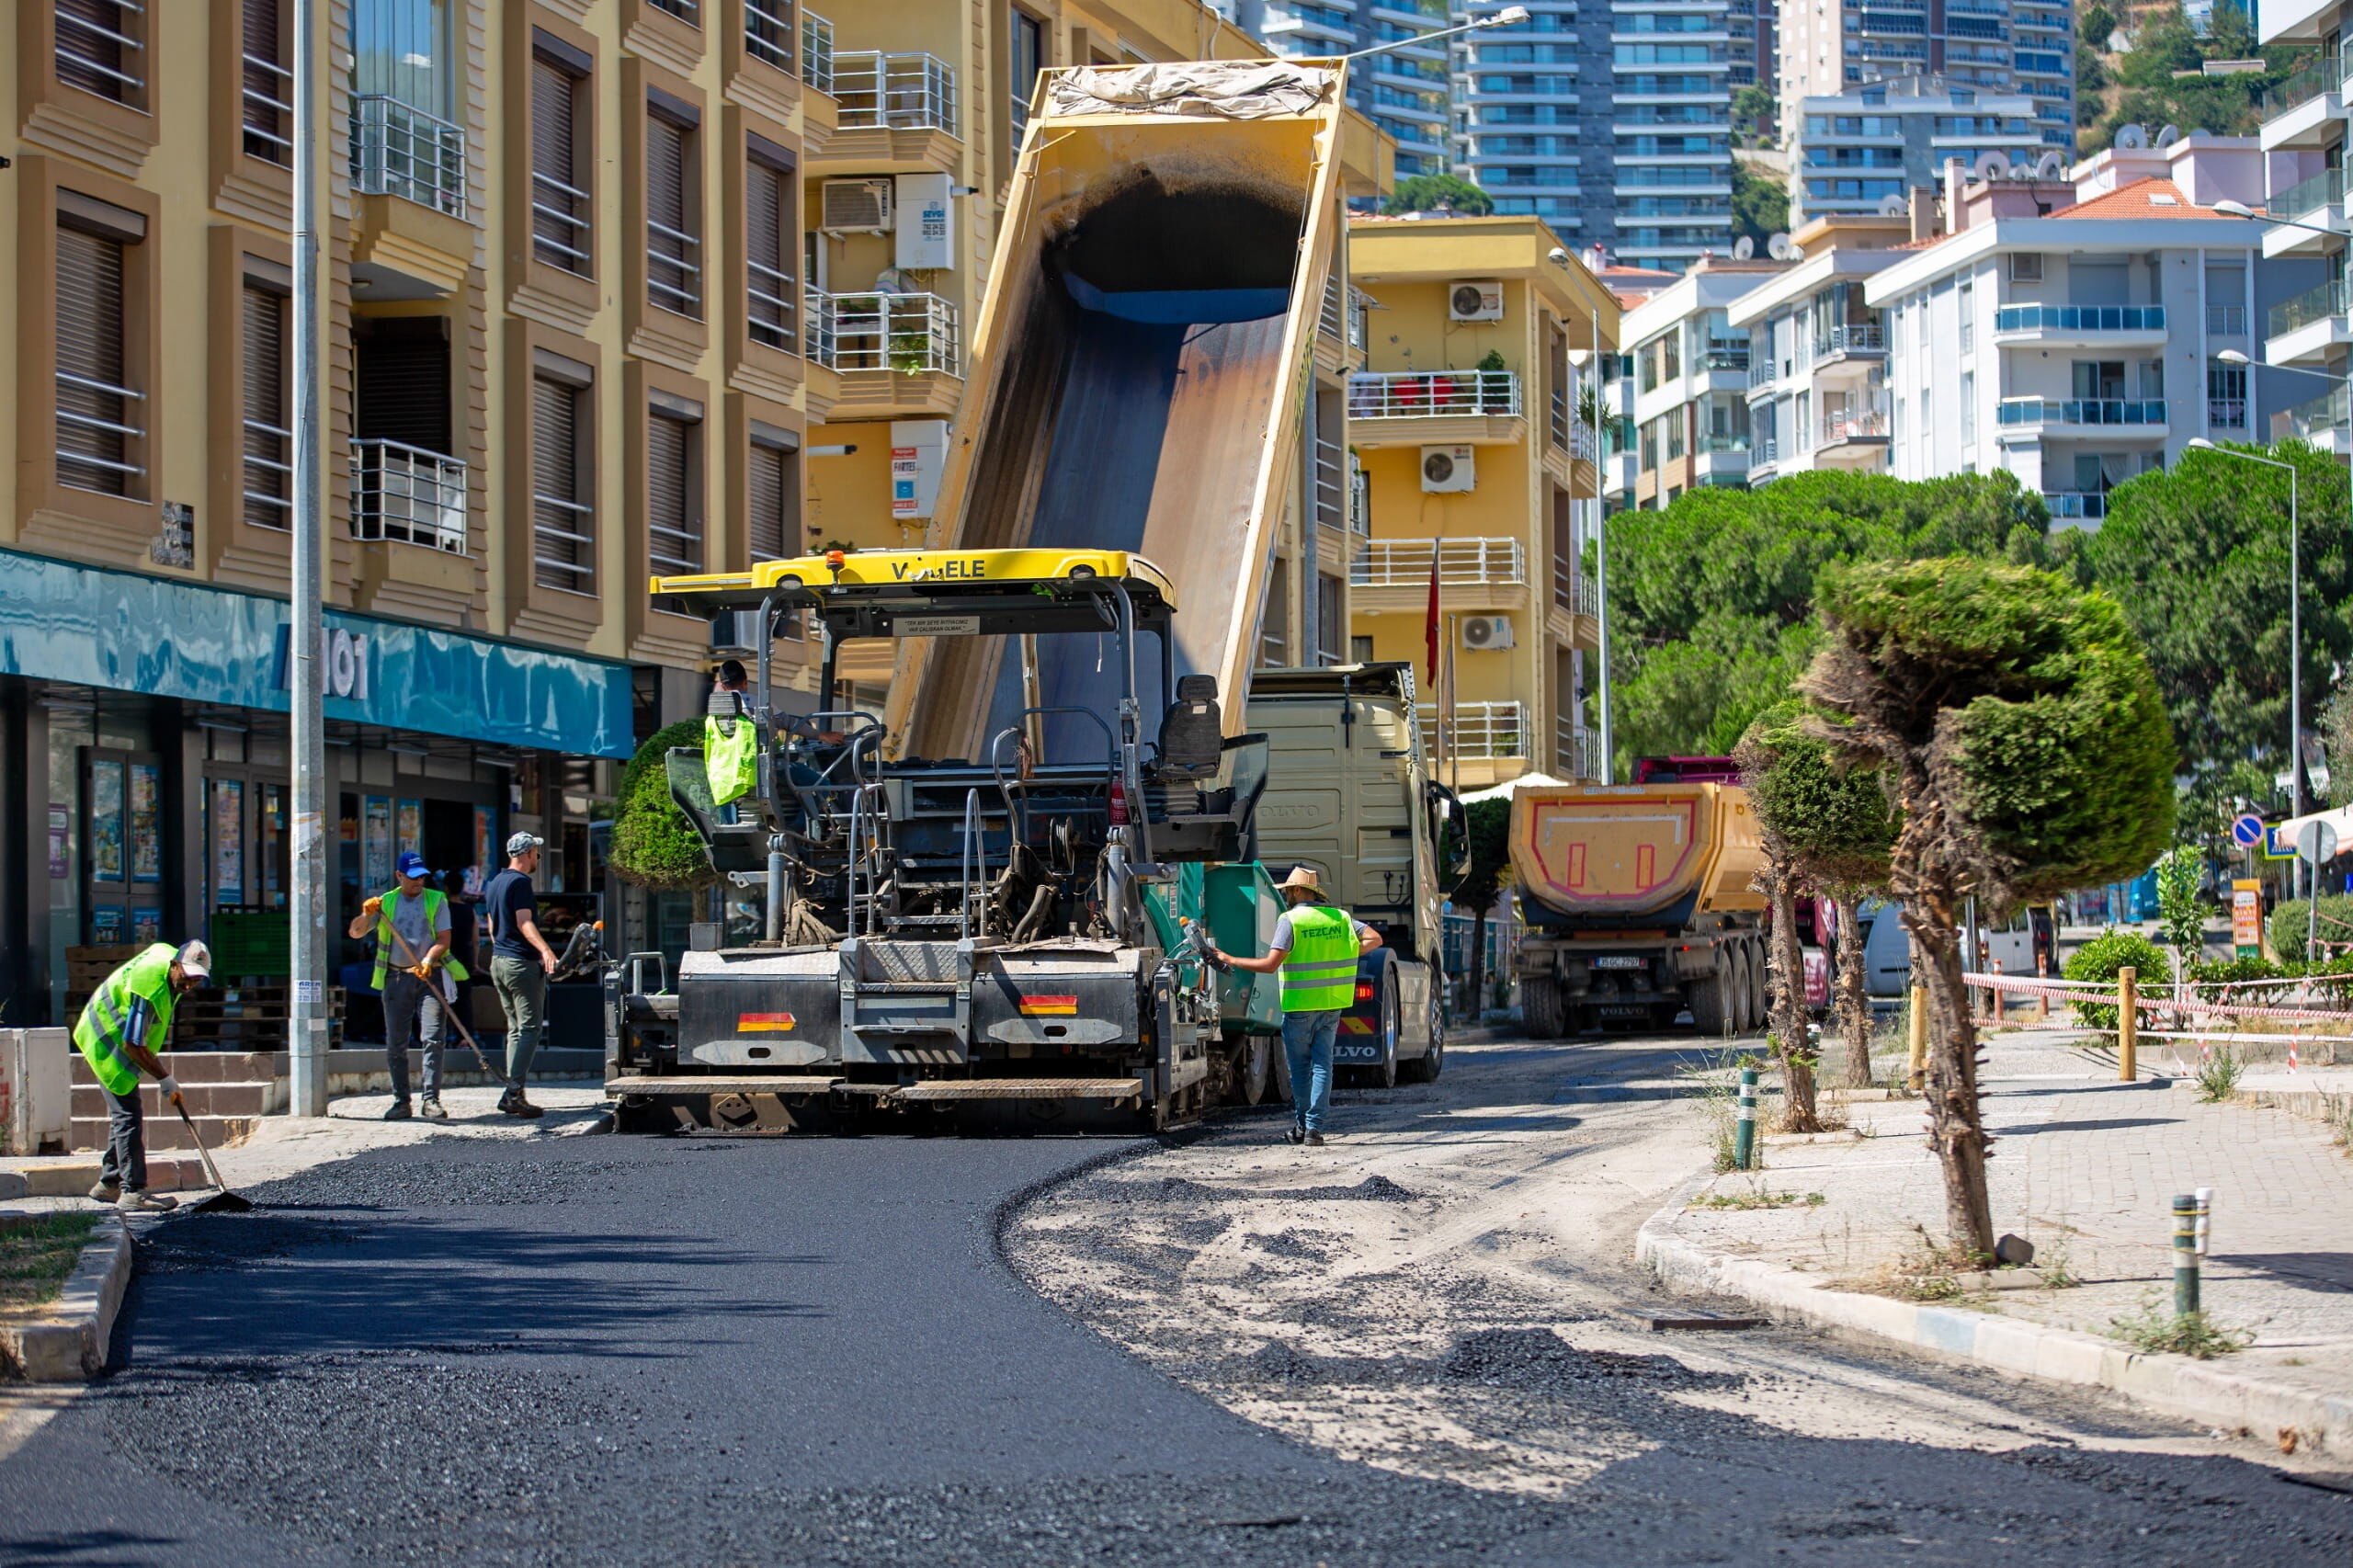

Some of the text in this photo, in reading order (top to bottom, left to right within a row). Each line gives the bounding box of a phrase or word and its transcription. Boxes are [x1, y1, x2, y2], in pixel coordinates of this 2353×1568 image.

[892, 560, 985, 580] VELE
[271, 623, 368, 700] 101
[1302, 926, 1342, 938] TEZCAN
[1600, 1006, 1644, 1016] VOLVO
[1334, 1046, 1376, 1057] LVO
